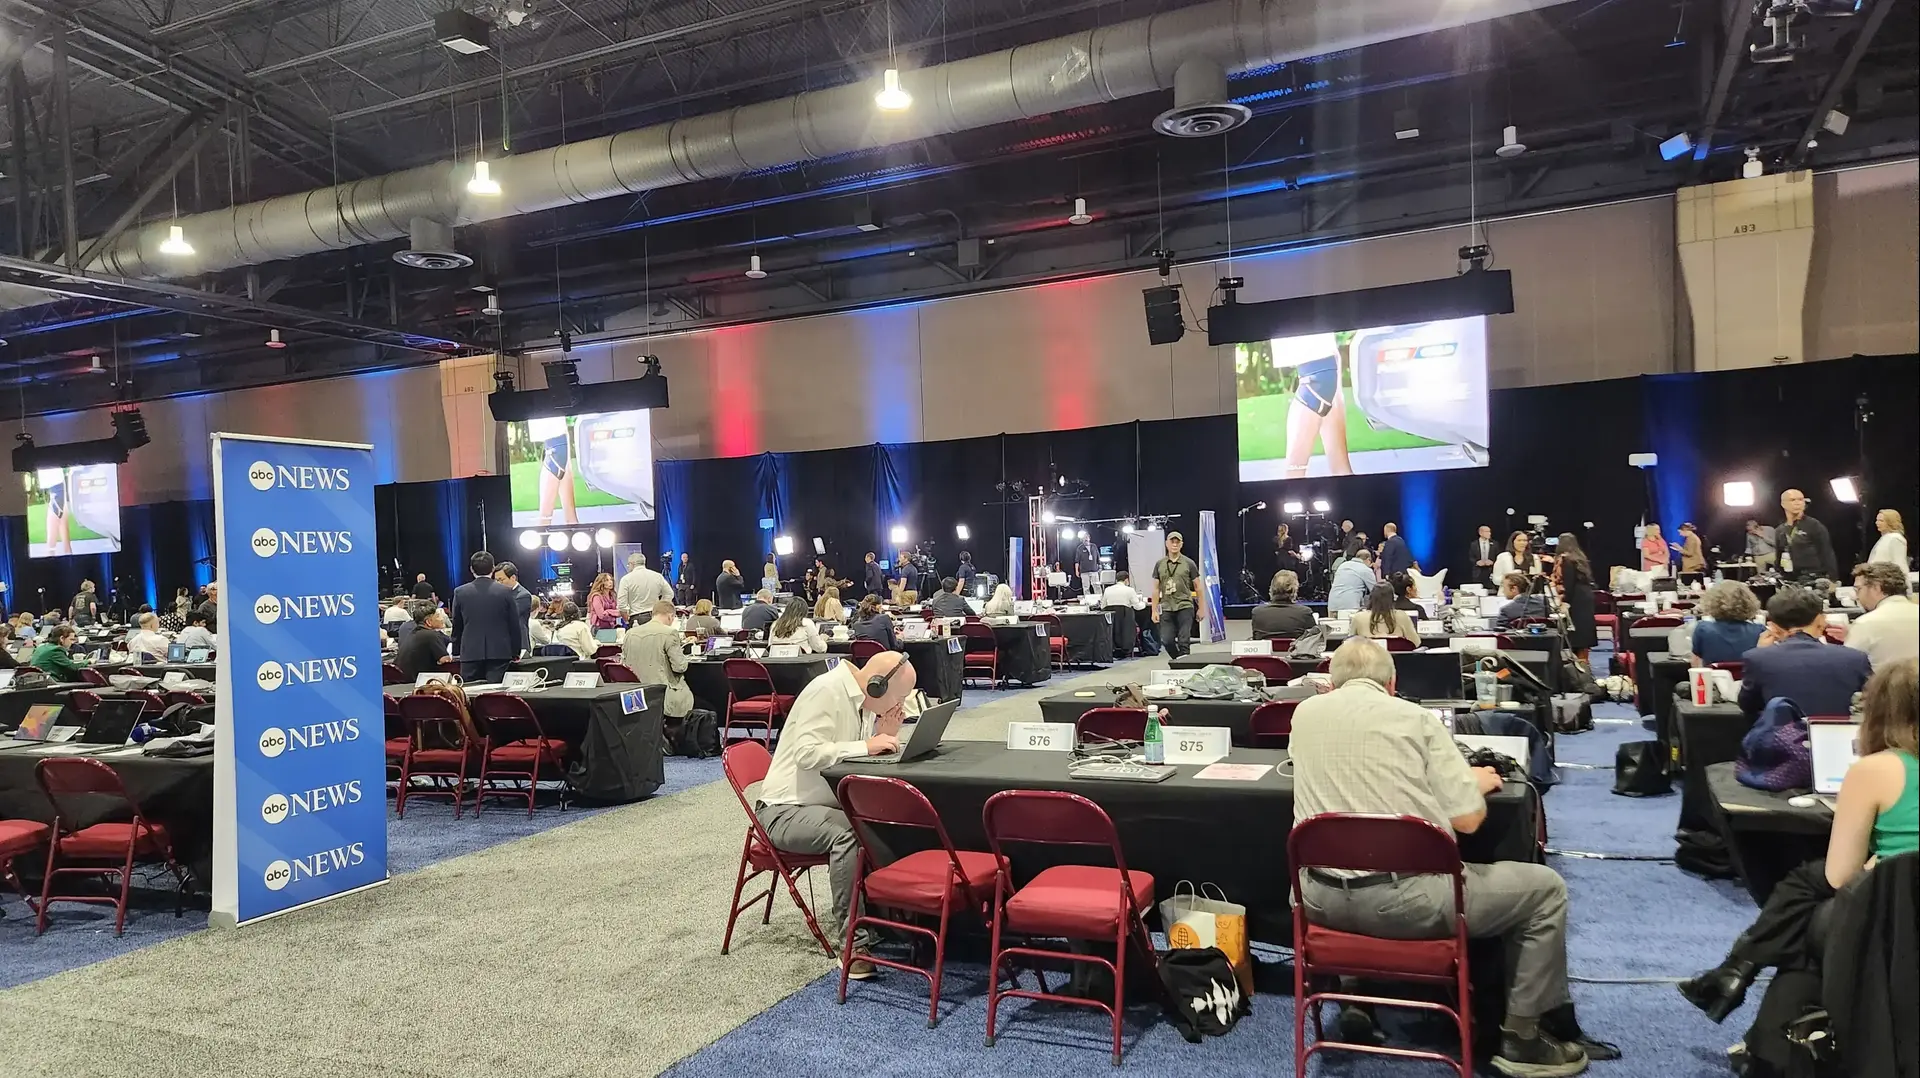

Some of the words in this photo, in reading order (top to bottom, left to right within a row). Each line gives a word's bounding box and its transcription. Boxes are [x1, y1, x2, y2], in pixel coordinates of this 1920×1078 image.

[250, 469, 274, 480] abc
[276, 465, 350, 491] NEWS
[253, 536, 277, 547] abc
[279, 530, 353, 554] NEWS
[256, 603, 280, 614] abc
[282, 593, 355, 620] NEWS
[259, 670, 282, 681] abc
[285, 655, 358, 686] NEWS
[261, 737, 285, 748] abc
[288, 718, 360, 751] NEWS
[1028, 735, 1051, 747] 876
[1179, 740, 1204, 752] 875
[264, 802, 288, 815] abc
[290, 780, 362, 817] NEWS
[266, 868, 289, 881] abc
[292, 842, 364, 882] NEWS
